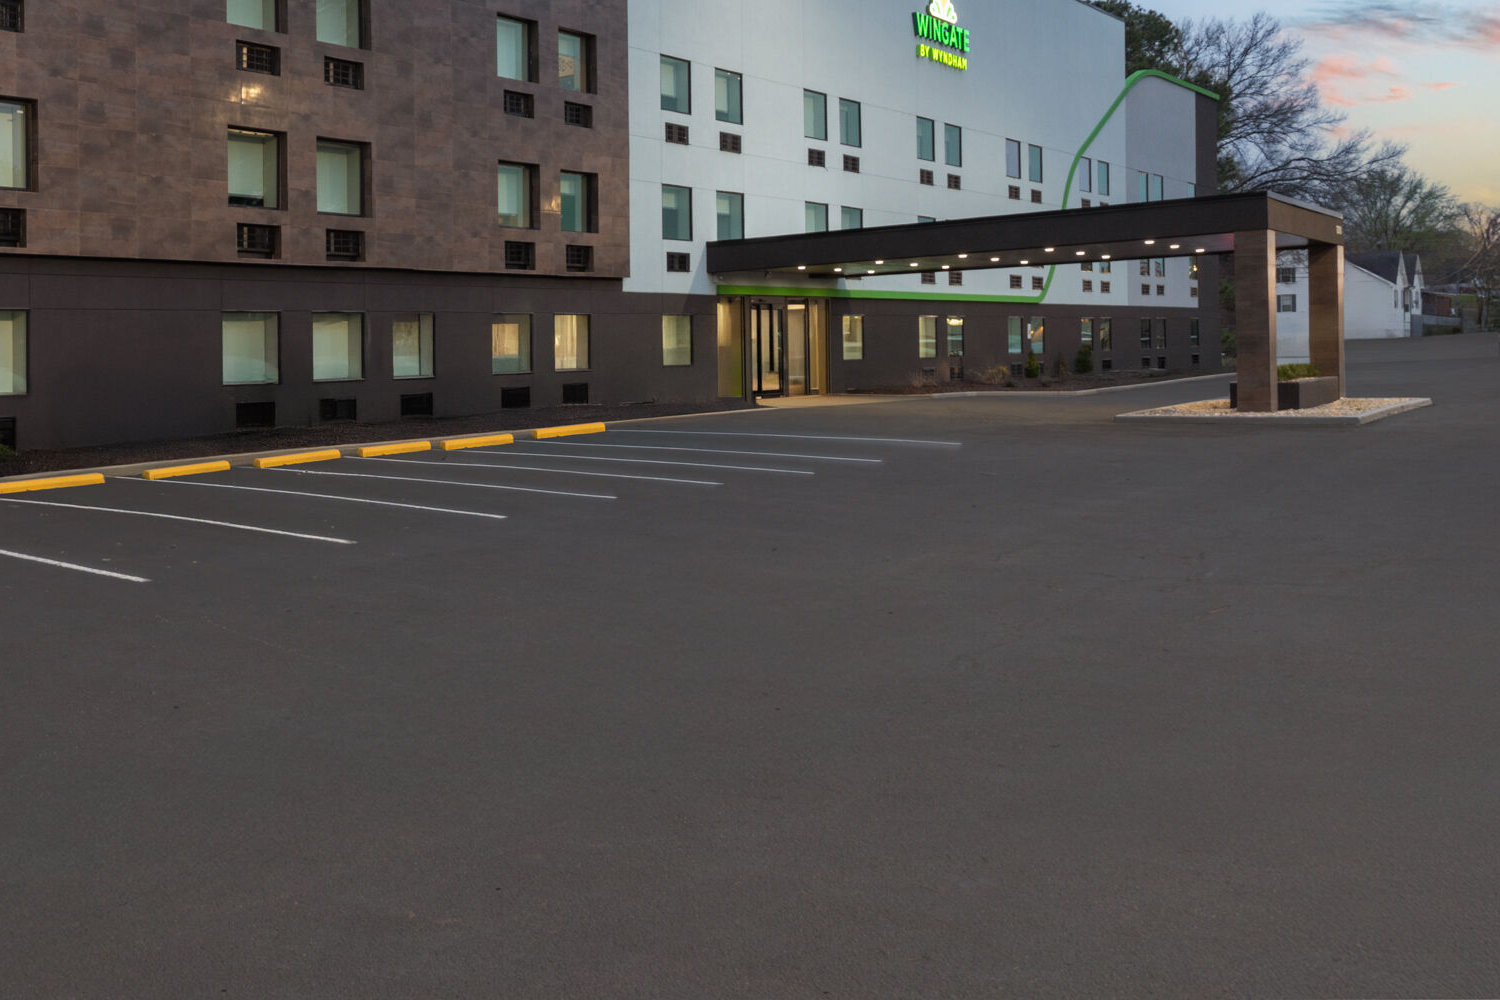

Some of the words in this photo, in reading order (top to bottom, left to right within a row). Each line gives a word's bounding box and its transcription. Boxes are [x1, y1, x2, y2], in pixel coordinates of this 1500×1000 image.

[915, 11, 970, 52] WINGATE
[920, 43, 930, 57] BY
[932, 47, 967, 70] WYNDHAM
